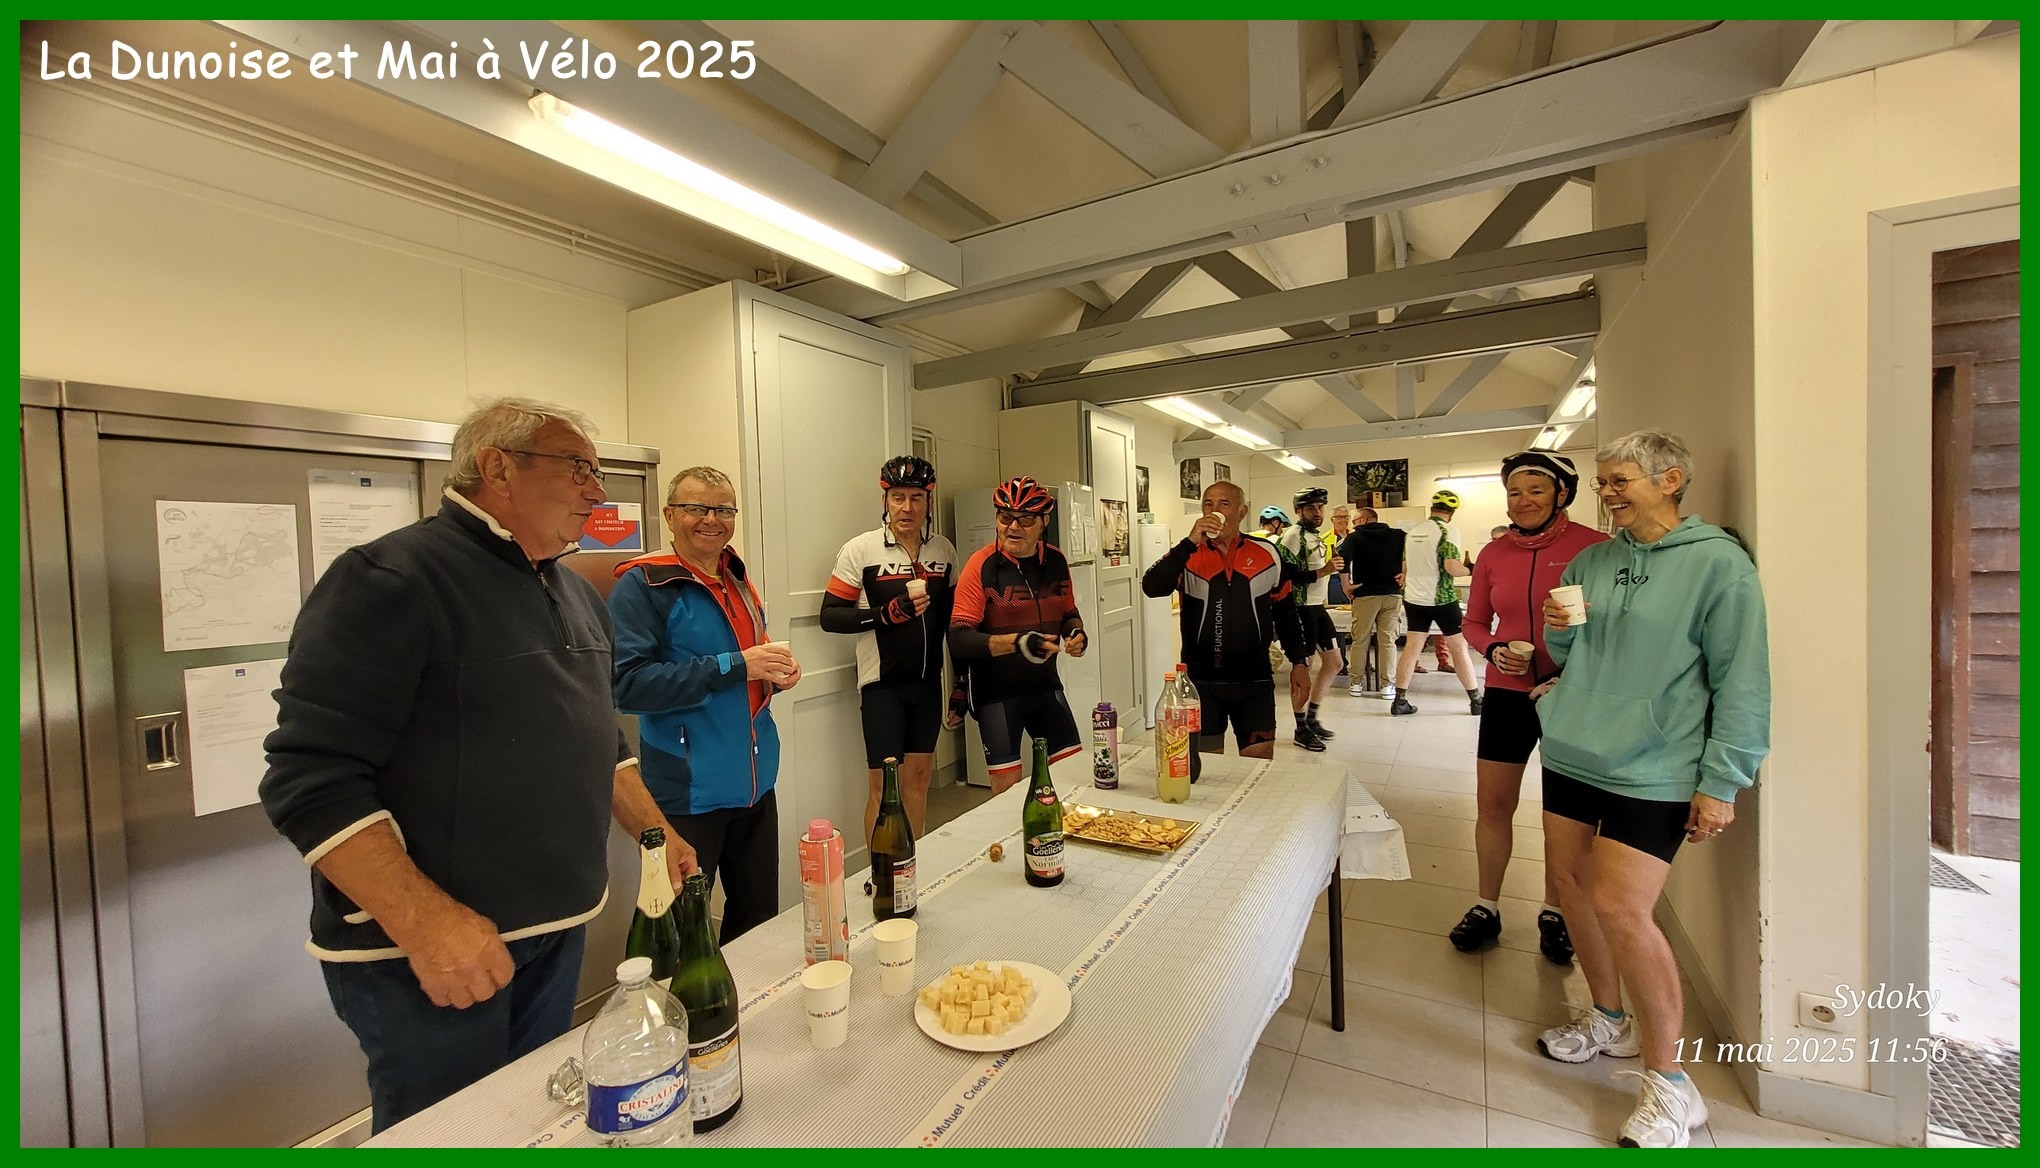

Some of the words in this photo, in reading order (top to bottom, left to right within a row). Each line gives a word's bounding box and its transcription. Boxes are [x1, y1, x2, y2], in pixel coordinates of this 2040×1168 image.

[1214, 598, 1223, 652] FUNCTIONAL
[1067, 974, 1083, 991] rédit
[963, 1076, 991, 1101] Crédit
[992, 1047, 1020, 1070] Mutue
[619, 1076, 684, 1113] CRISTALINE
[931, 1103, 966, 1138] Mutuel
